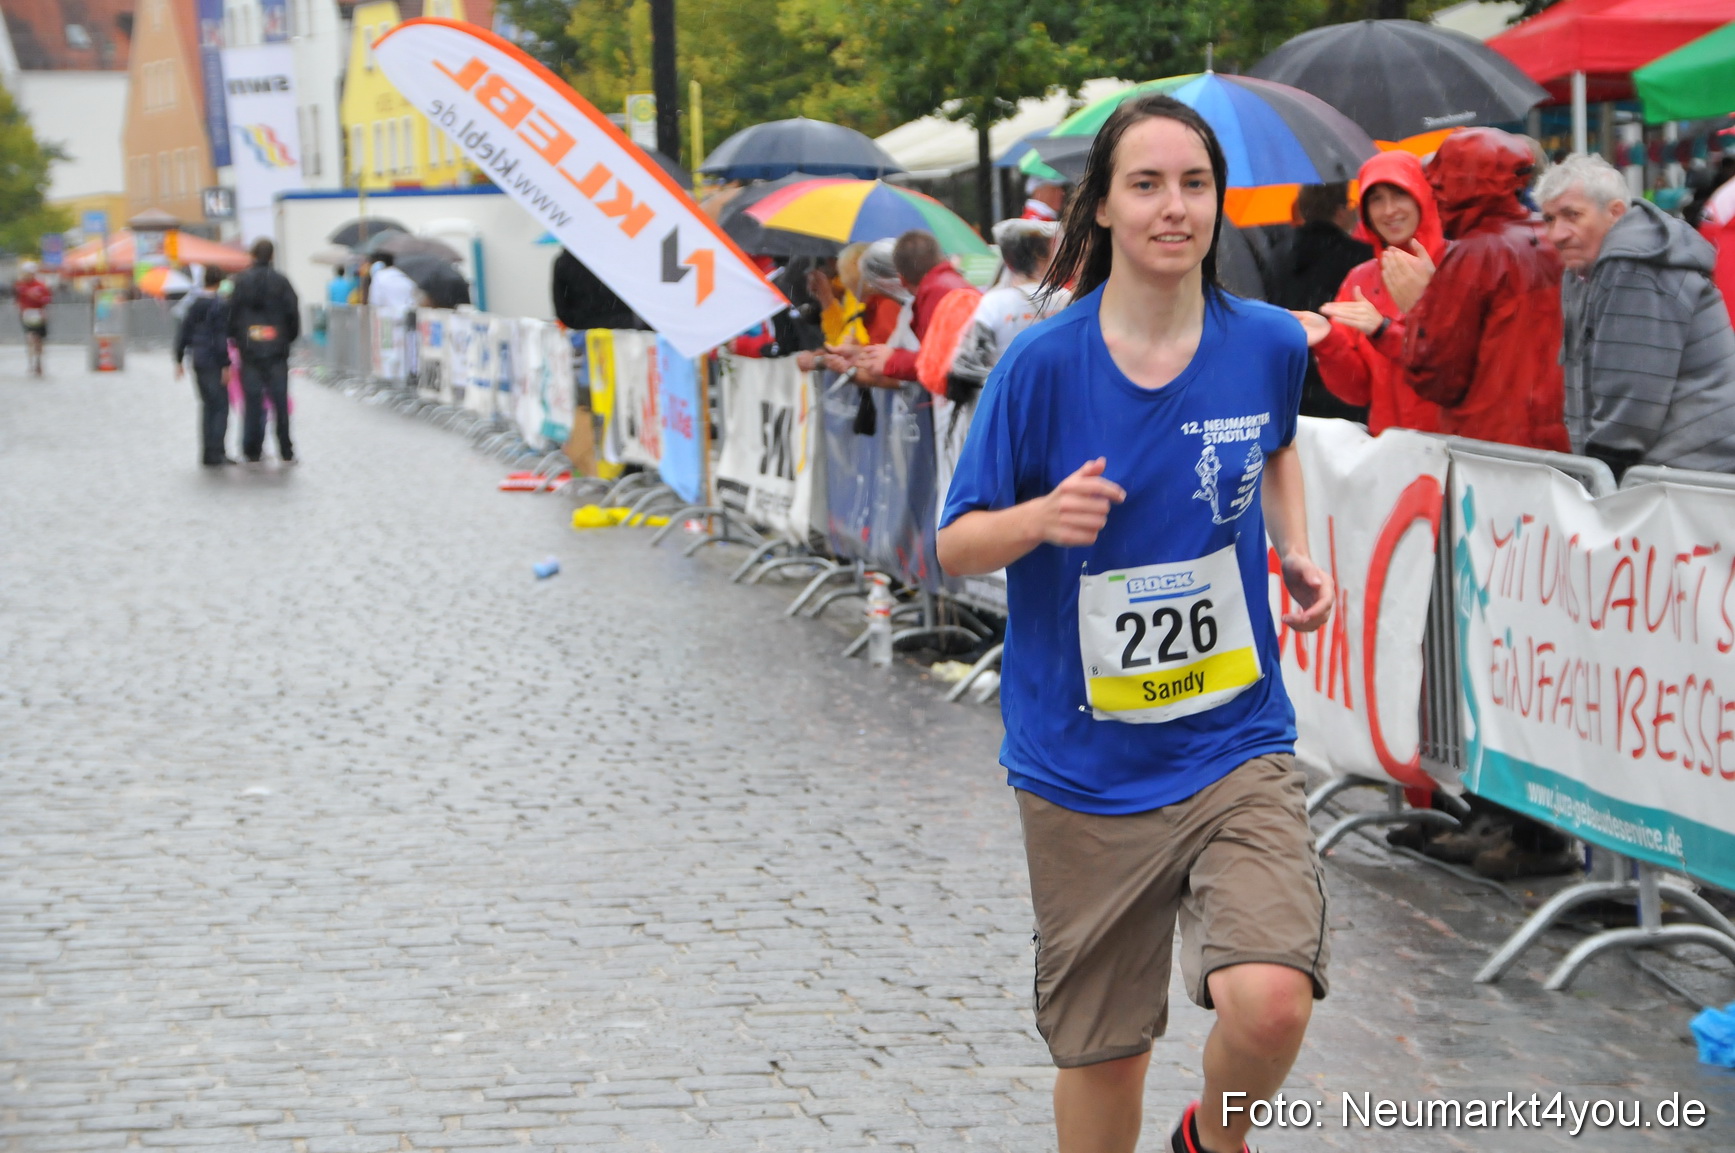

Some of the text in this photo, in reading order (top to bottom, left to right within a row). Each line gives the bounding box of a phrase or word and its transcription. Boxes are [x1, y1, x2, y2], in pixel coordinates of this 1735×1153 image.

[1181, 411, 1270, 435] 12. NEUMARKTER
[1202, 426, 1261, 445] STADTLAUF
[1127, 571, 1195, 594] BOCK
[1116, 598, 1217, 669] 226
[1142, 671, 1205, 702] Sandy
